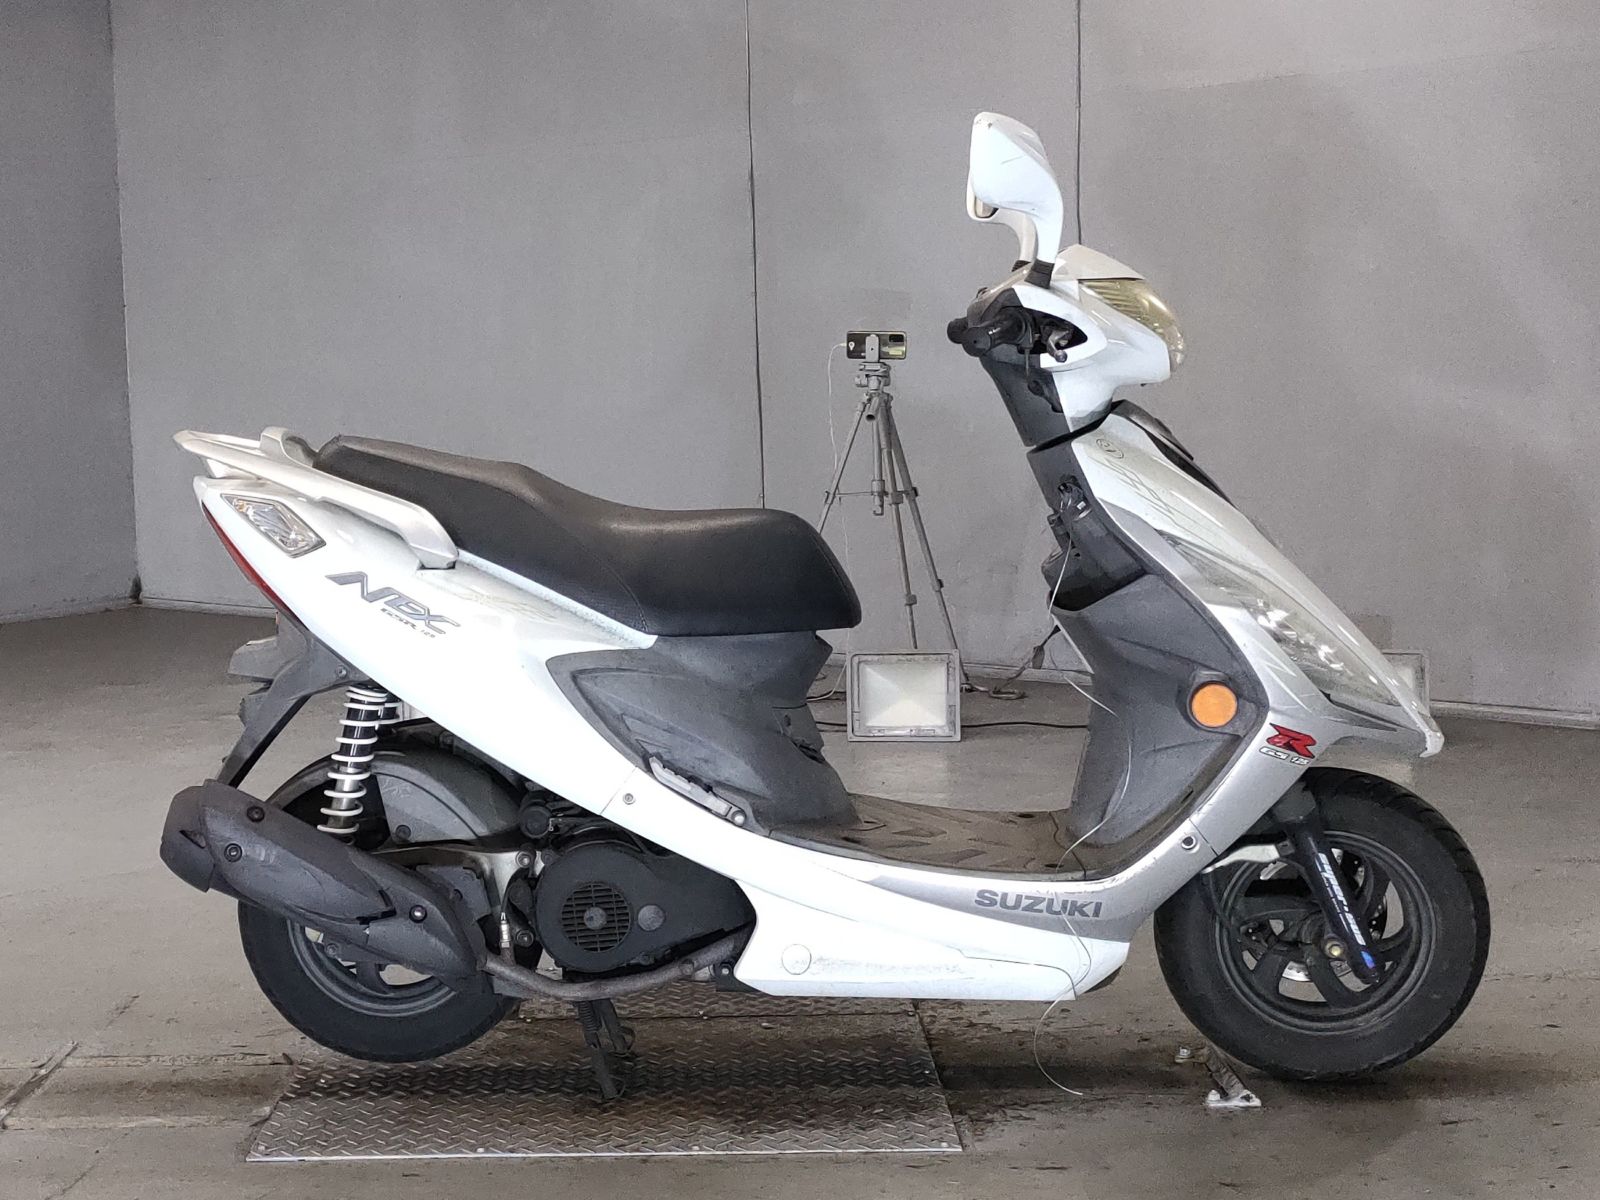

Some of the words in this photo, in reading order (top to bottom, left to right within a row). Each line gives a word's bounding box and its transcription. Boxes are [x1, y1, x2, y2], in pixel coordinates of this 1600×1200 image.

[325, 571, 461, 634] NEX
[1266, 722, 1316, 759] R
[974, 889, 1103, 918] SUZUKI
